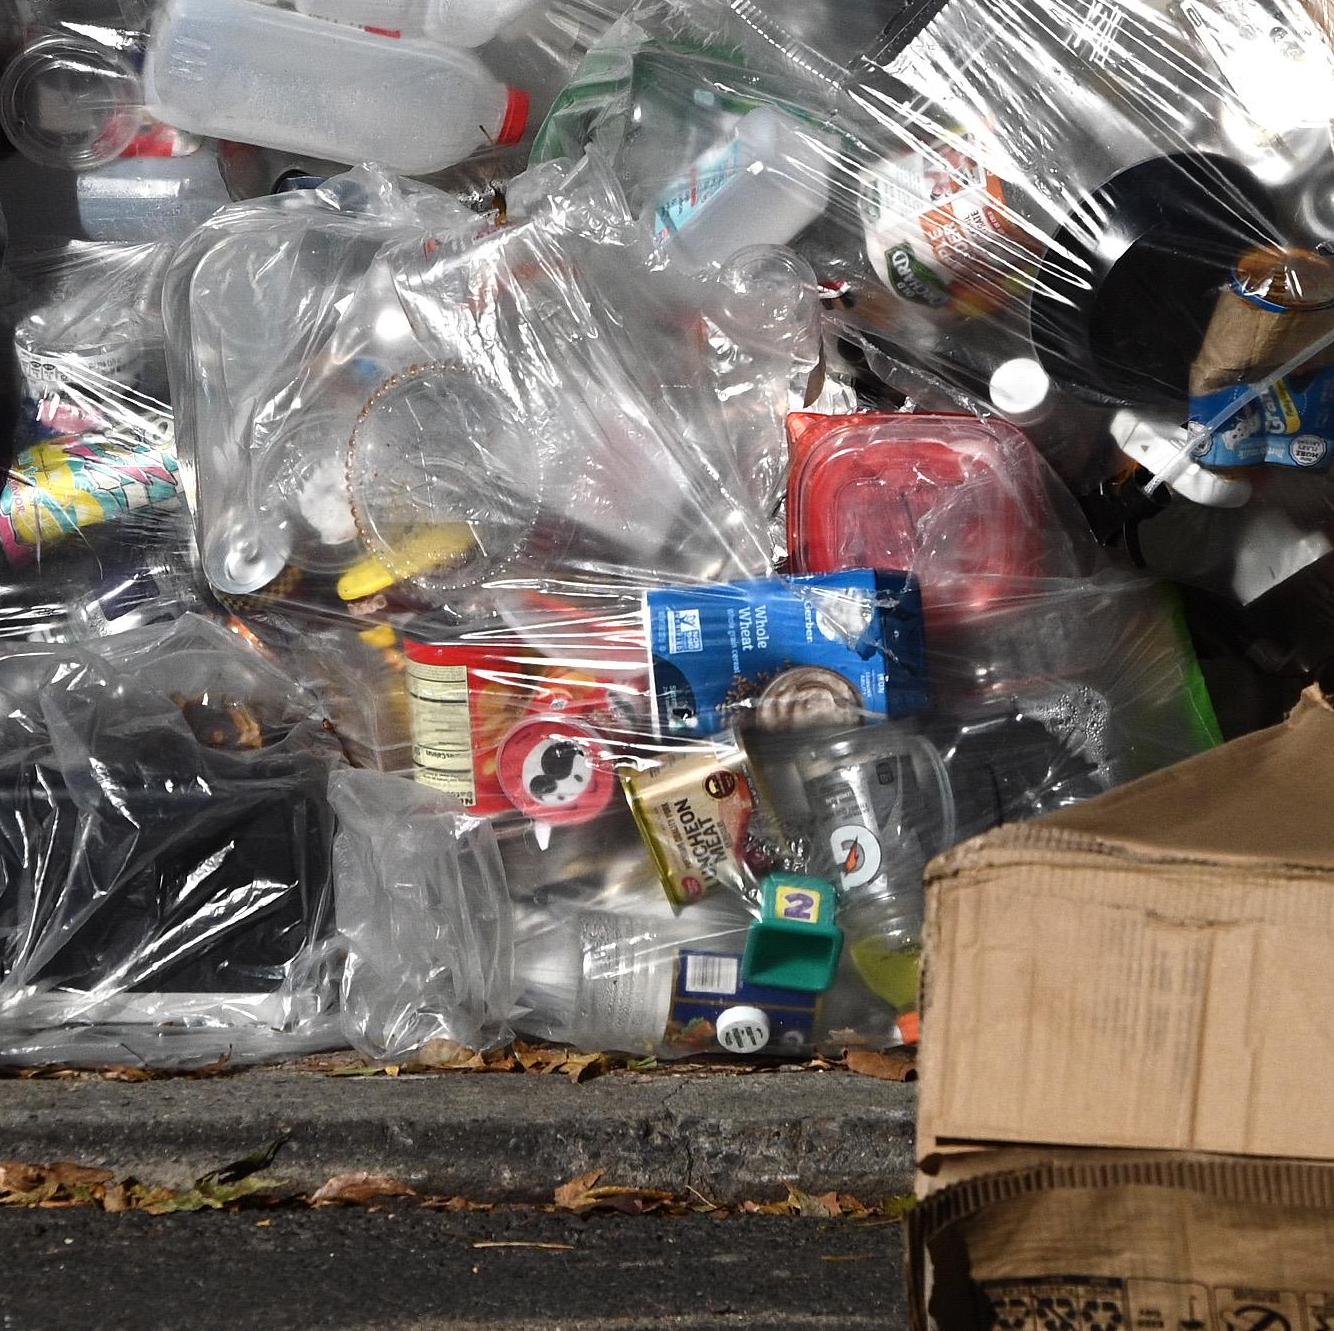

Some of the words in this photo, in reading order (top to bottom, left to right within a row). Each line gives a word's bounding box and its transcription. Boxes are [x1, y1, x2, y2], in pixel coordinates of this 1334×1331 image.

[897, 280, 915, 300] OLD
[1295, 450, 1319, 458] MORE
[727, 607, 735, 630] Whole
[737, 605, 753, 652] Wheat
[754, 604, 768, 650] Whole
[803, 600, 814, 644] Gerber
[692, 629, 700, 651] NON
[729, 629, 739, 649] grain
[731, 648, 741, 674] cereal
[673, 798, 720, 889] LUNCHEON
[697, 814, 726, 864] MEAT
[830, 824, 883, 892] G
[783, 891, 815, 920] 2
